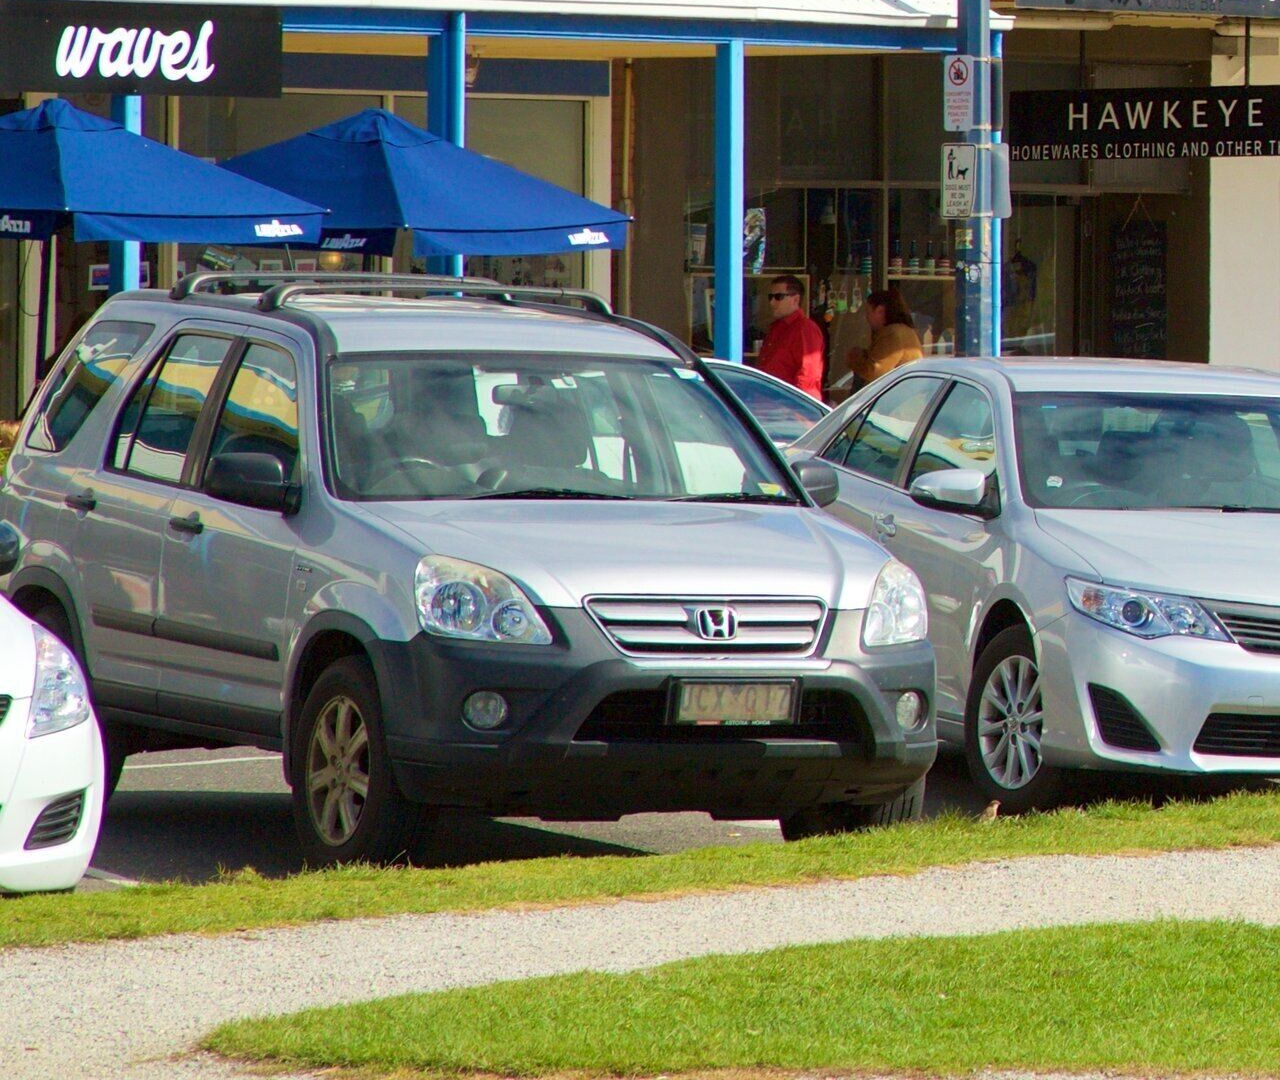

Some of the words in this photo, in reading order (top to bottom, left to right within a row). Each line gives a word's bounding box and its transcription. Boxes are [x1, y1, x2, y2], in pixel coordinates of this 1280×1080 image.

[56, 19, 215, 83] waves
[1068, 98, 1264, 131] HAWKEYE
[1012, 142, 1099, 160] HOMEWARES
[1105, 141, 1175, 159] CLOTHING
[1181, 141, 1209, 157] AND
[1215, 140, 1262, 156] OTHER
[0, 215, 31, 233] AZZA
